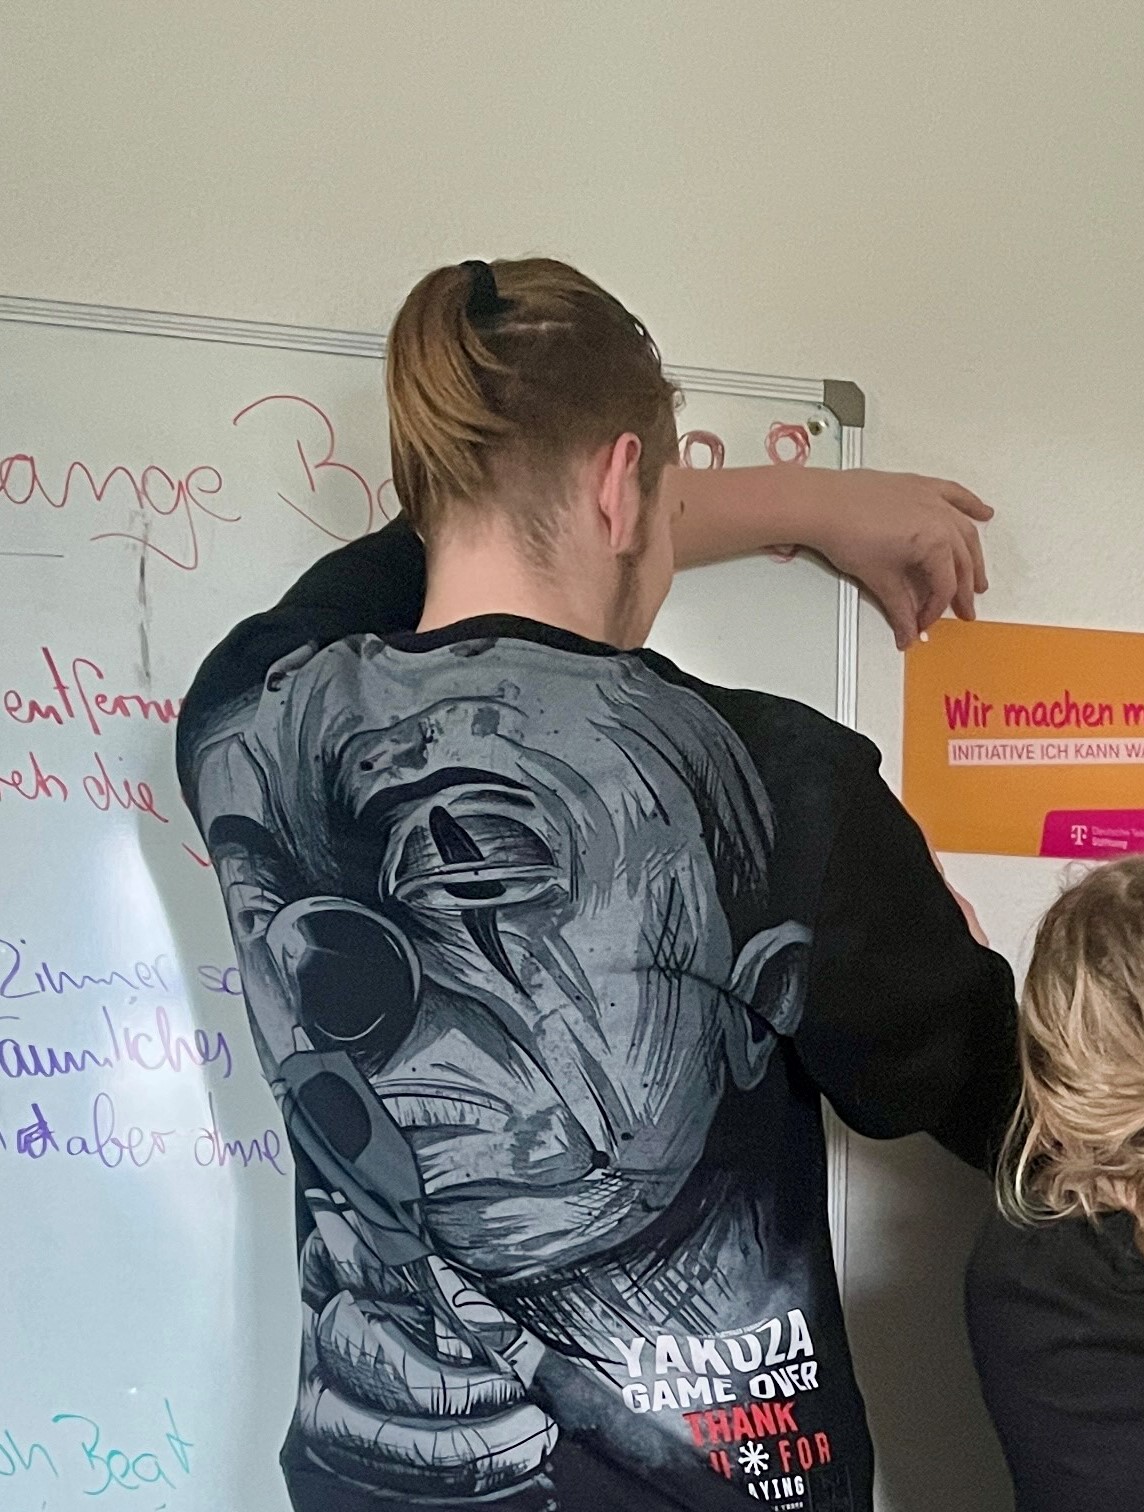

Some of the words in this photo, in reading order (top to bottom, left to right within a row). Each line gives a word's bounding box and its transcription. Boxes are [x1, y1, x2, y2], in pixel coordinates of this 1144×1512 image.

[944, 689, 994, 730] Wir
[1003, 689, 1114, 729] machen
[951, 743, 1036, 762] INITIATIVE
[1040, 743, 1070, 760] ICH
[1074, 742, 1120, 760] KANN
[82, 751, 169, 823] die
[608, 1307, 815, 1379] YAKUZA
[621, 1376, 737, 1414] GAME
[748, 1360, 819, 1399] OVER
[682, 1400, 799, 1448] THANK
[777, 1431, 833, 1474] FOR
